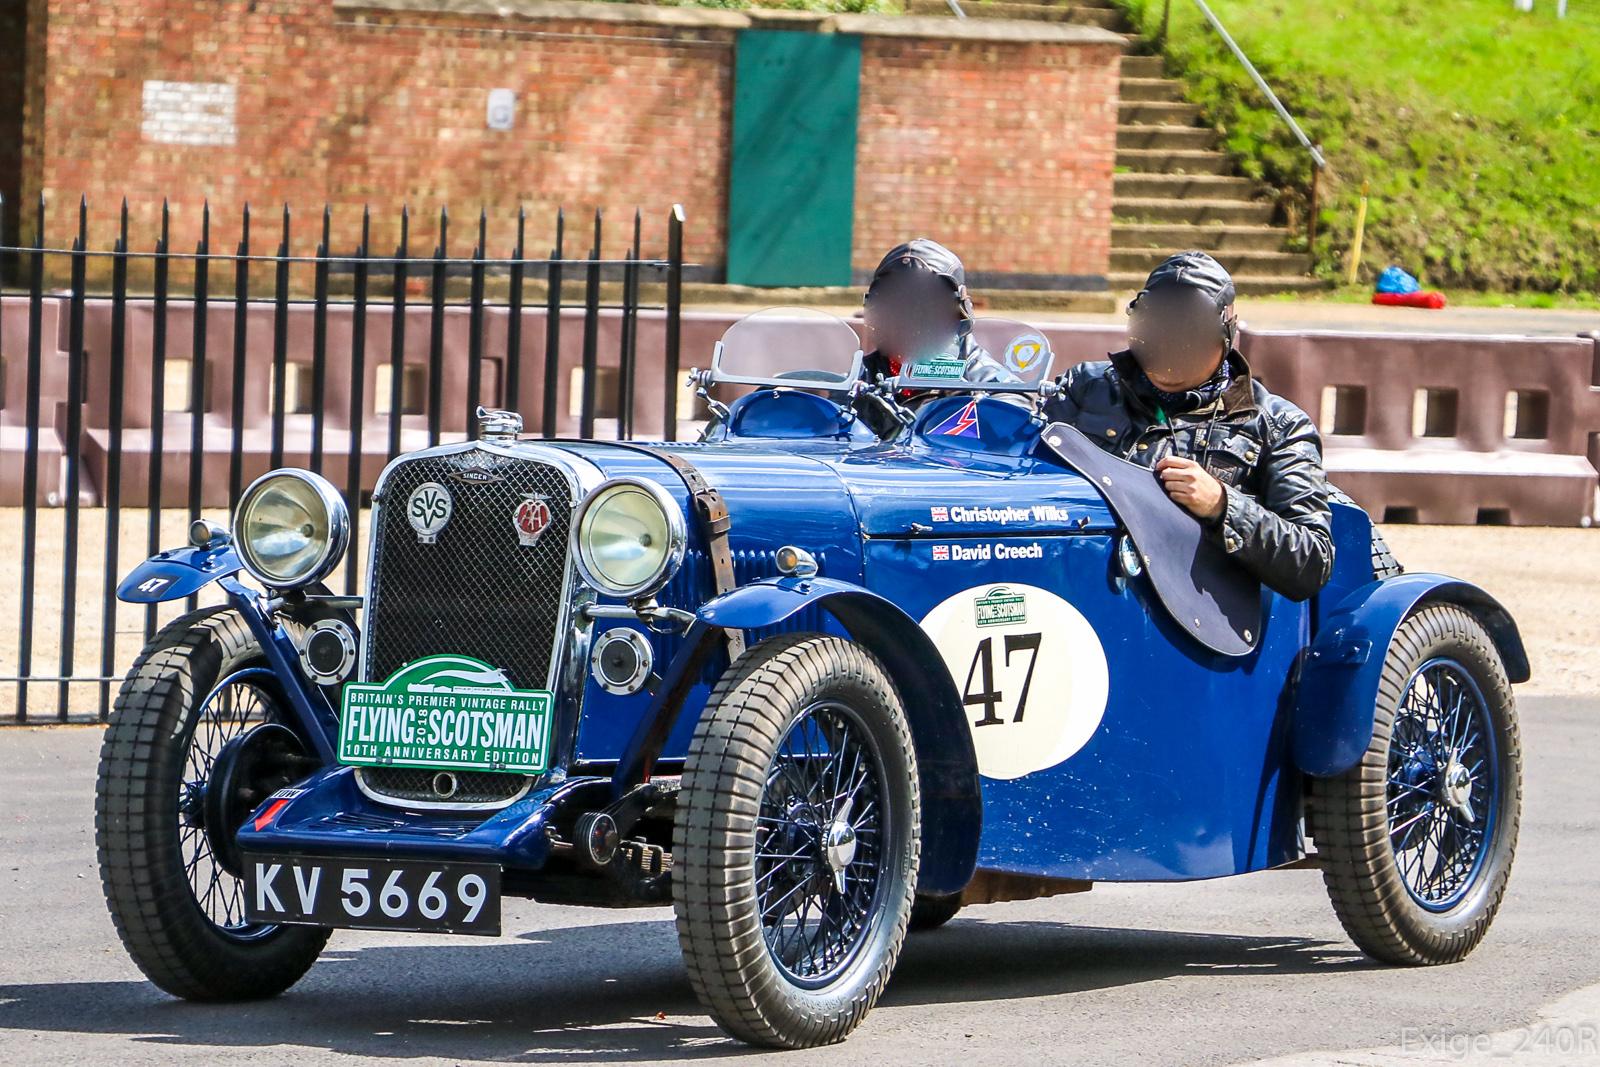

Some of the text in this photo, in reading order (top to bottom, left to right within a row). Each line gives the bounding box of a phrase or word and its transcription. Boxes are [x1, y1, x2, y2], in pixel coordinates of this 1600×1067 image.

[462, 472, 488, 481] SINGER
[950, 505, 1069, 525] Christopher Wilks
[951, 542, 1043, 561] David Creech
[137, 577, 169, 593] 47
[962, 632, 1042, 728] 47
[350, 692, 545, 712] BRITAIN'S PREMIER VINTAGE RALLY
[347, 705, 543, 750] FLYING SCOTSMAN
[416, 708, 428, 745] 2018
[346, 744, 539, 764] 10TH ANNIVERSARY EDITION
[274, 789, 300, 798] TOW
[255, 862, 487, 923] KV 5669
